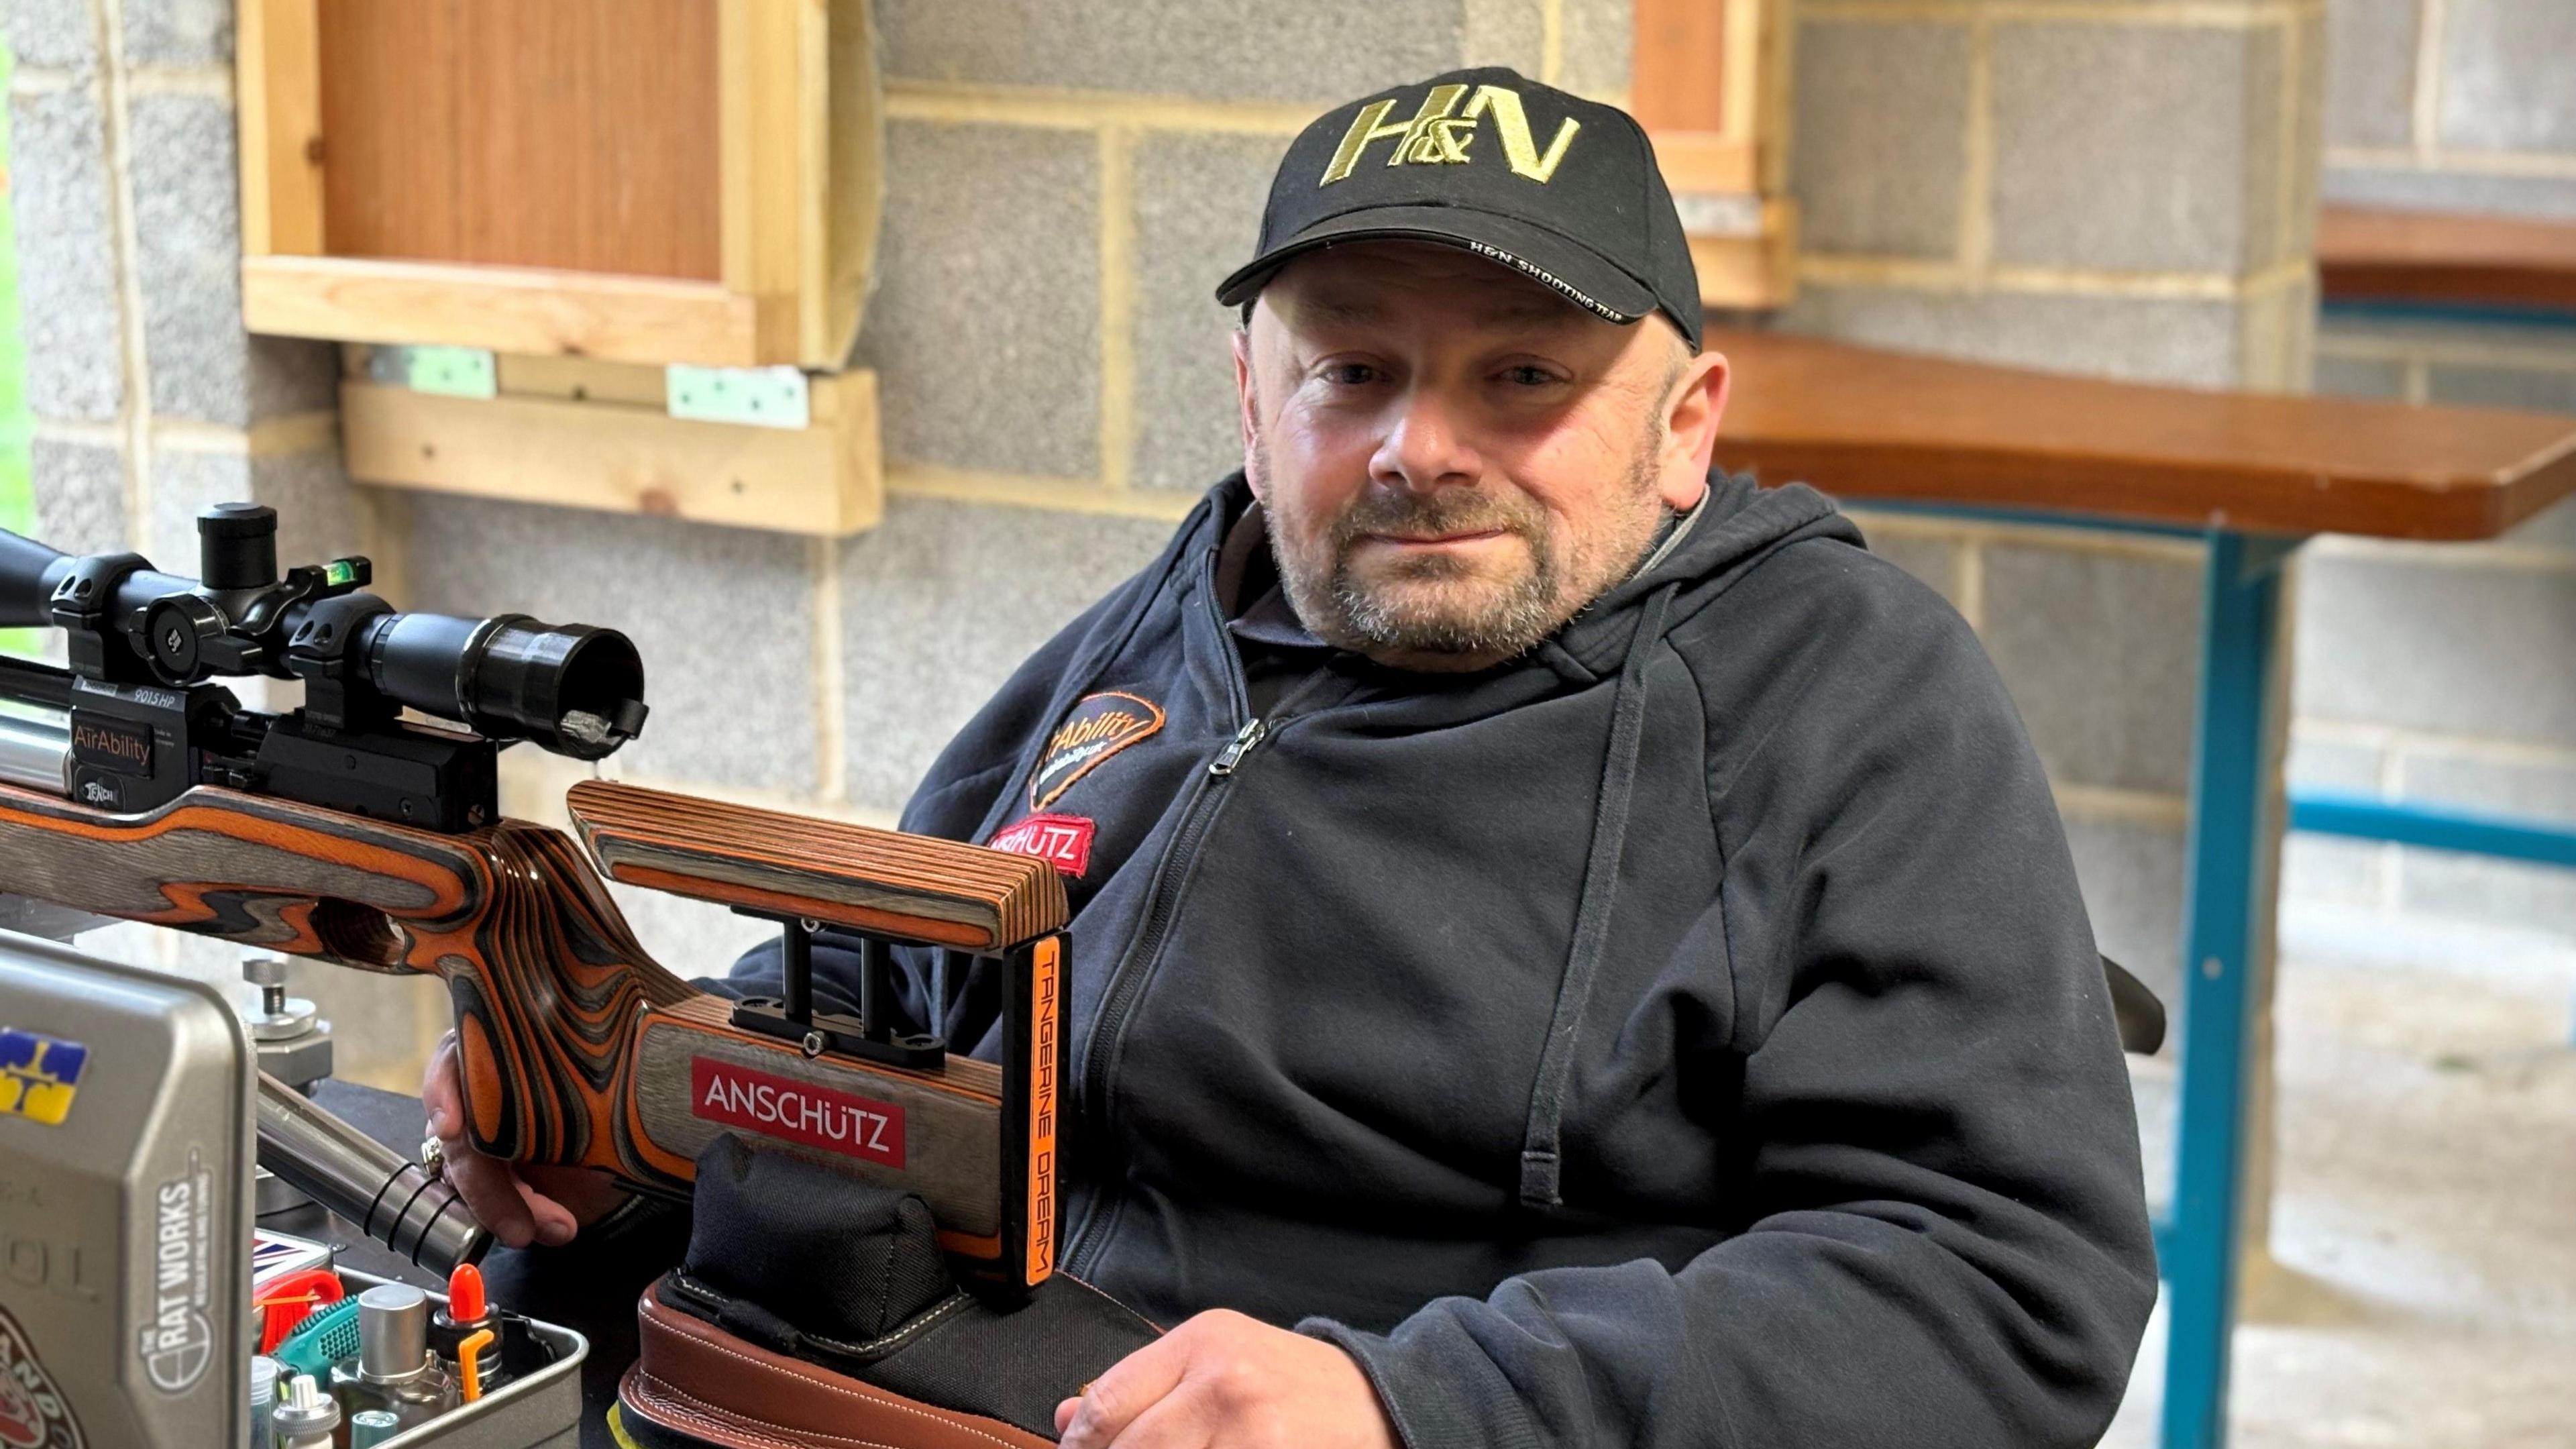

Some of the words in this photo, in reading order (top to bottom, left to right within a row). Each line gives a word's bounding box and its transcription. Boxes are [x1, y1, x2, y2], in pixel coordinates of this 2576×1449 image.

[1319, 84, 1580, 187] H&N
[1470, 241, 1512, 263] H&N
[1517, 260, 1594, 309] SHOOTING
[1595, 303, 1622, 321] TEAM
[74, 725, 150, 766] AirAbility
[1038, 950, 1055, 1139] TANGERINE
[704, 1073, 890, 1152] ANSCHÜTZ
[158, 1183, 191, 1290] WORKS
[1034, 1151, 1053, 1272] DREAM
[158, 1294, 189, 1349] RAT
